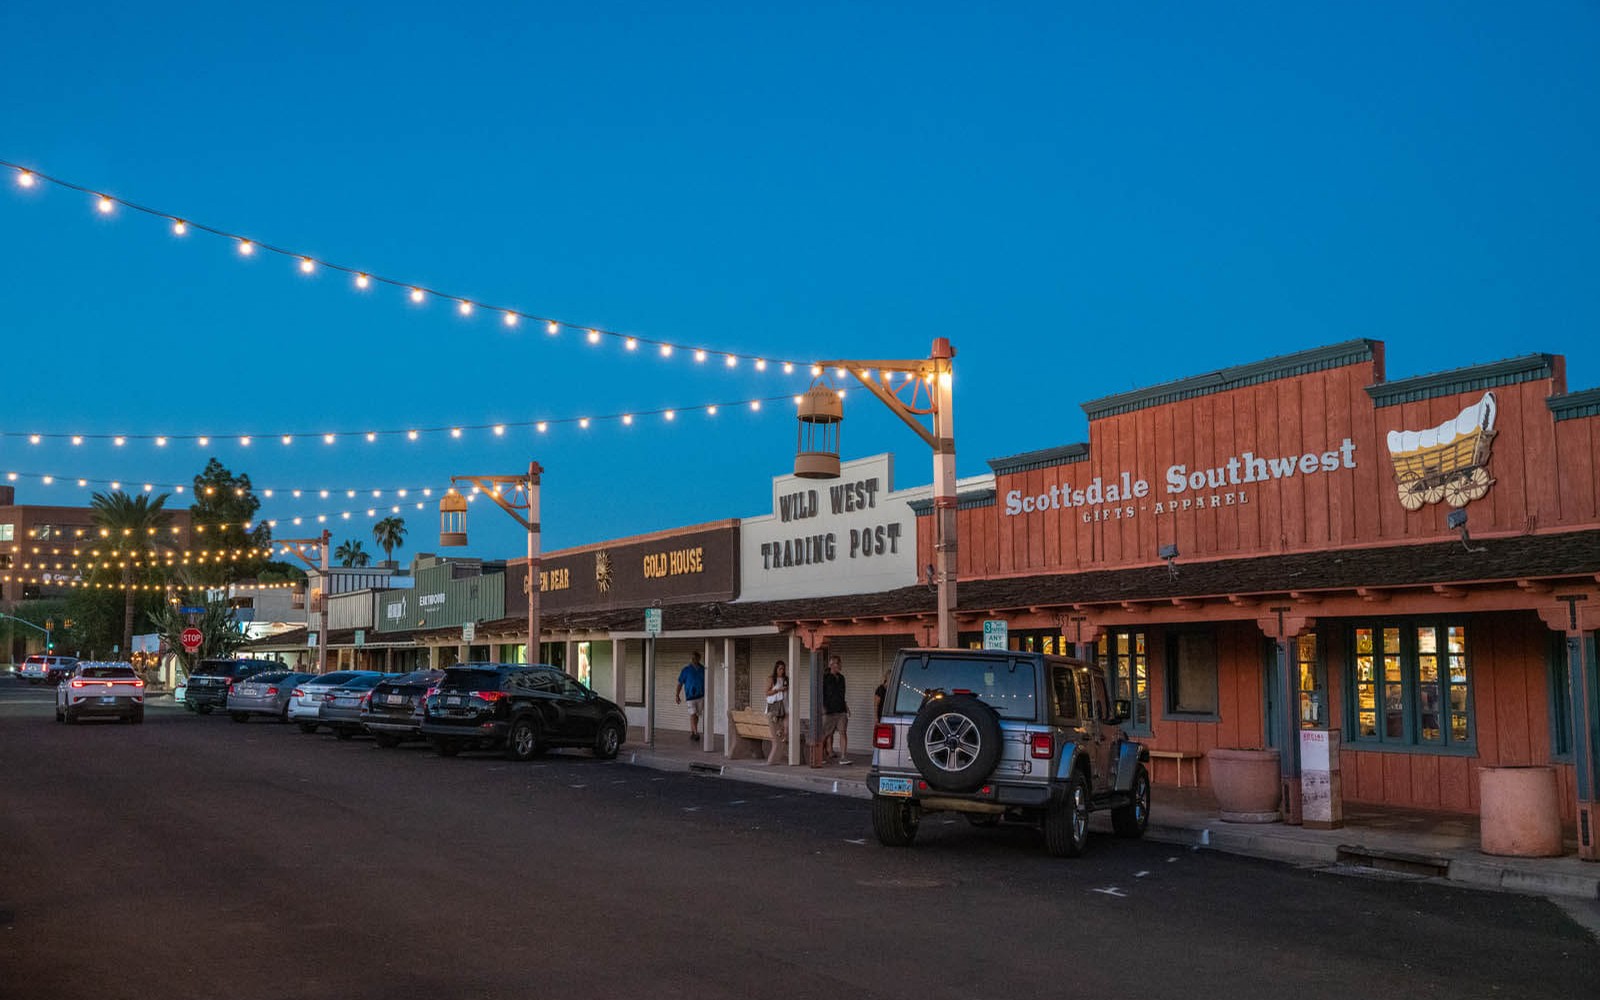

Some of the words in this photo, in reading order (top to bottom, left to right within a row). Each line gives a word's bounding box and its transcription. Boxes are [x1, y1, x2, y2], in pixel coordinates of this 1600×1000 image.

[1005, 472, 1149, 516] Scottsdale
[1166, 438, 1356, 493] Southwest
[779, 489, 818, 523] WILD
[830, 477, 879, 515] WEST
[1082, 504, 1135, 524] GIFTS
[1154, 490, 1250, 514] APPAREL
[761, 532, 837, 570] TRADING
[849, 522, 901, 559] POST
[643, 552, 667, 579] GOLD
[670, 547, 703, 576] HOUSE
[523, 571, 549, 594] GEN
[550, 568, 569, 591] BEAR
[183, 634, 200, 642] STOP
[985, 622, 991, 632] 3
[988, 641, 1003, 649] TIME
